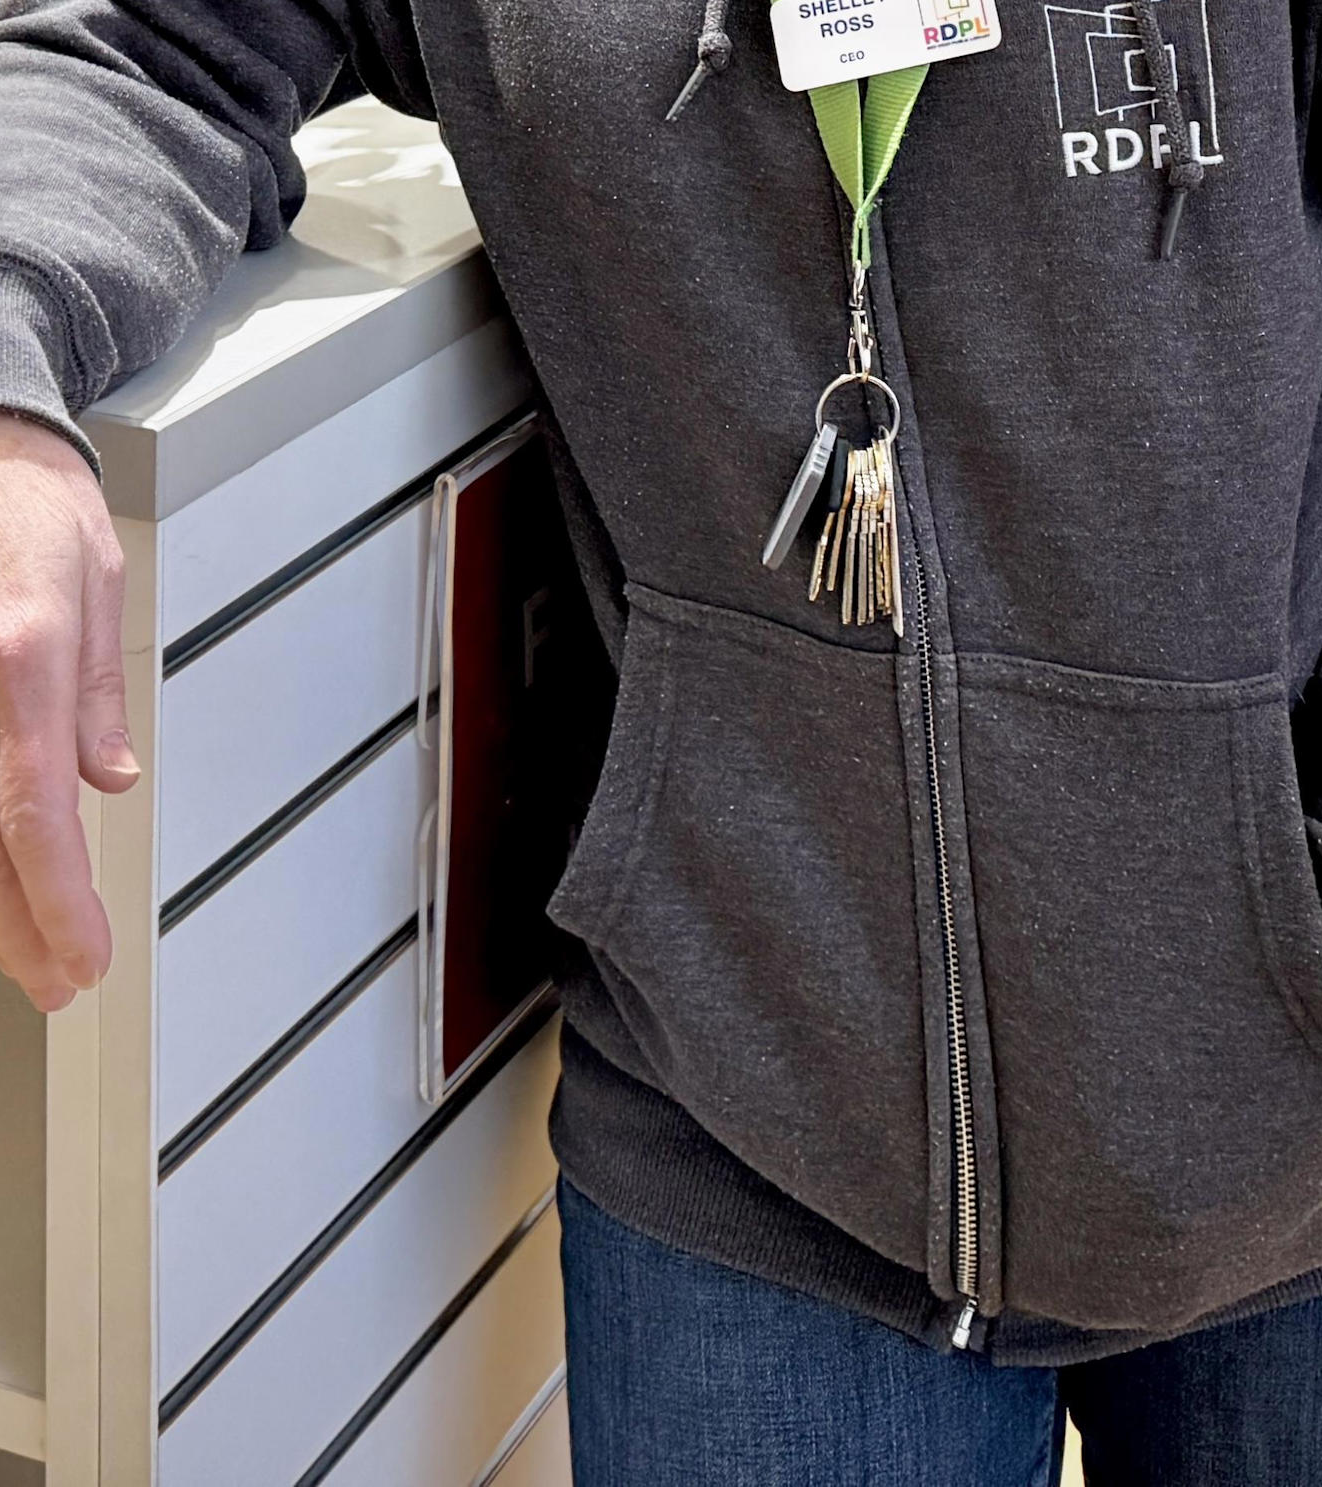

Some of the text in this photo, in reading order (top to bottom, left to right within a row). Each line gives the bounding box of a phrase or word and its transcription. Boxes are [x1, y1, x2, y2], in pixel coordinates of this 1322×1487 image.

[820, 13, 875, 38] ROSS
[923, 16, 991, 46] RDPL
[839, 49, 866, 64] CEO
